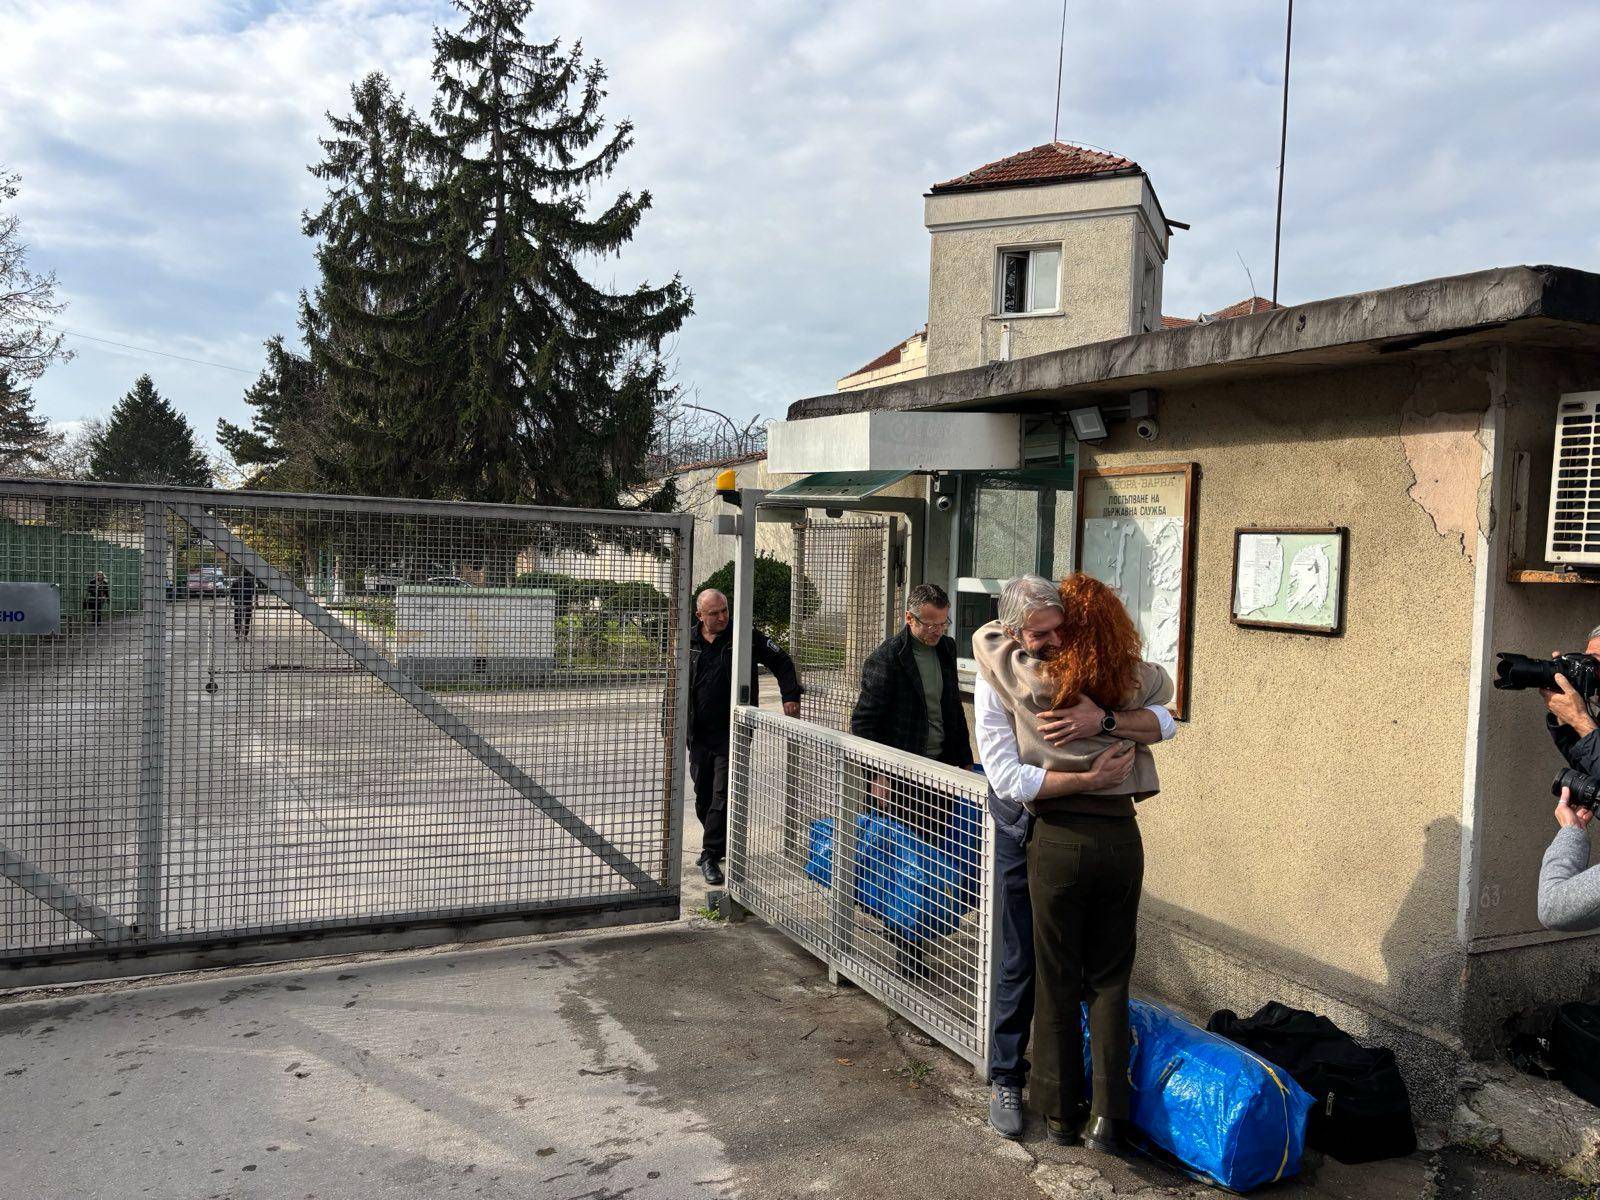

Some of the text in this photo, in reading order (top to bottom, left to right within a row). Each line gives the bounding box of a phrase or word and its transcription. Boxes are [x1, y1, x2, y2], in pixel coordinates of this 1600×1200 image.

[1108, 494, 1160, 505] ПОСТЪПВАНЕ НА
[1103, 506, 1167, 518] ДЪРЖАВНА СЛУЖБА
[0, 610, 25, 622] НО
